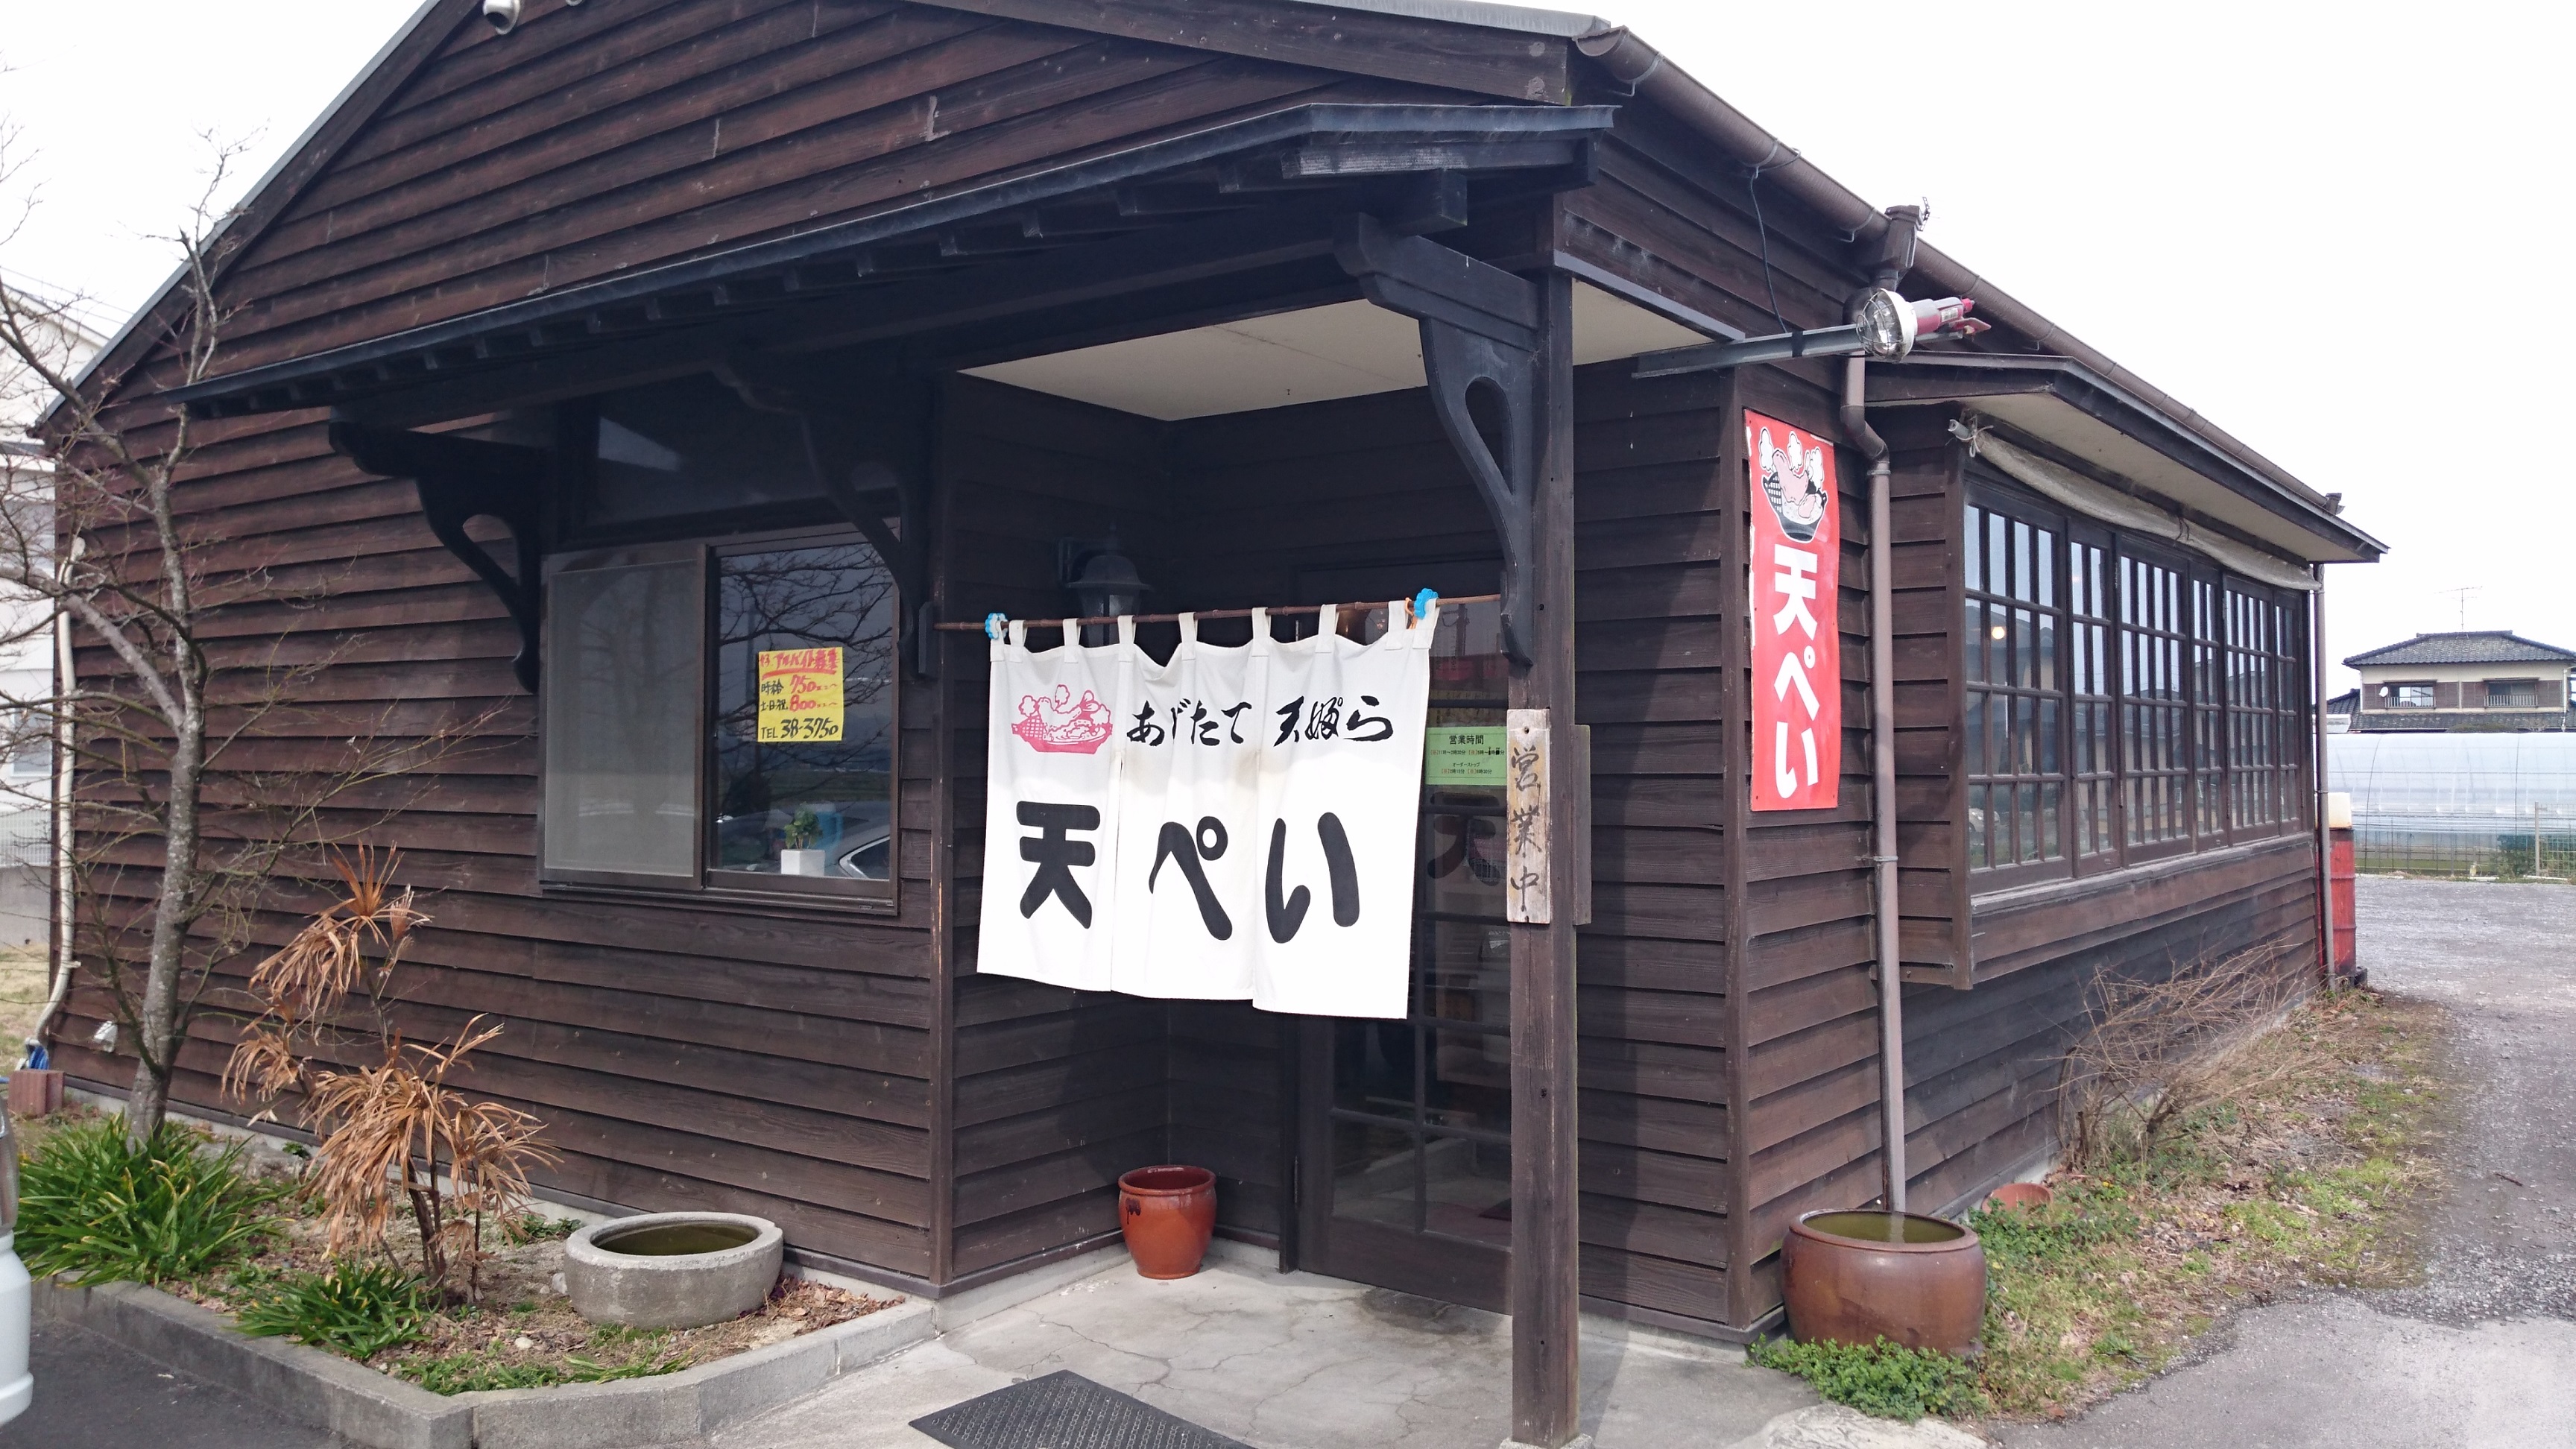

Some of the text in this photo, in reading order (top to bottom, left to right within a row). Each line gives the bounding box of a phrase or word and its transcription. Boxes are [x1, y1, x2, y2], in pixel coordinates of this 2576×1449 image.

[761, 678, 784, 695] 時給
[1772, 544, 1820, 799] 天ぺい
[761, 716, 839, 739] TEL 38-3750
[1448, 734, 1484, 745] 営業時間
[1510, 745, 1542, 912] 営業中
[1016, 801, 1361, 944] 天ぺい
